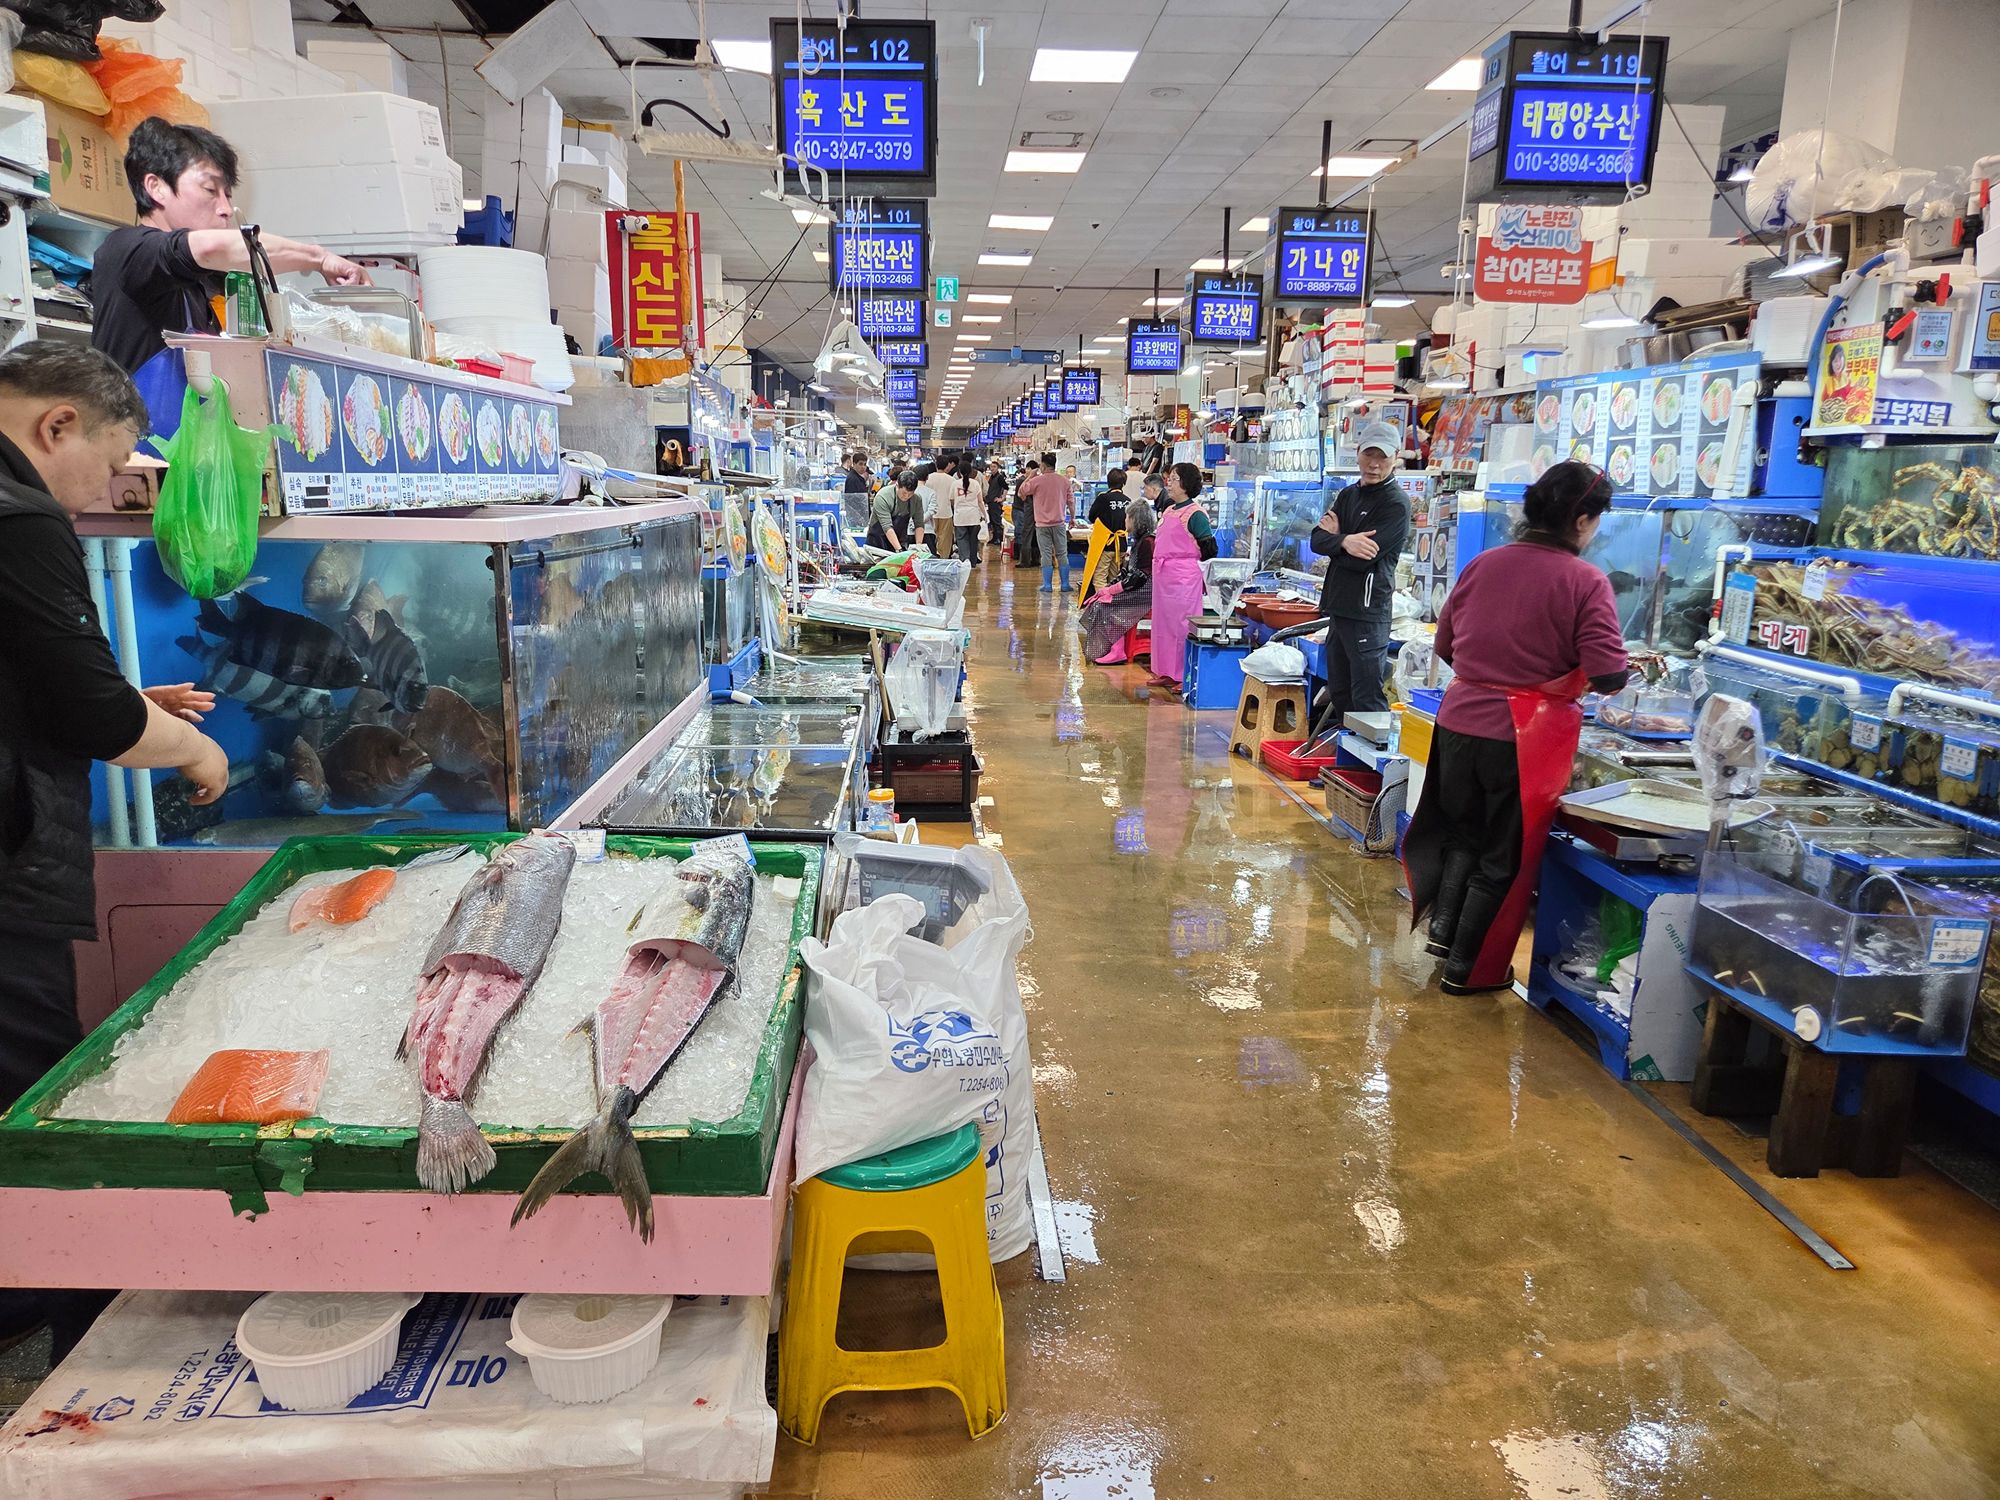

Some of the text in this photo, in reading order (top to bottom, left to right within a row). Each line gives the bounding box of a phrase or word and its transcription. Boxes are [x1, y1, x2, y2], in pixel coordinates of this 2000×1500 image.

[801, 38, 835, 60] 활어
[870, 40, 909, 61] 102
[1532, 51, 1567, 74] 활어
[1600, 54, 1638, 75] 119
[1522, 100, 1640, 141] 태평양수산
[794, 140, 912, 161] 010-3247-3979
[845, 209, 867, 223] 활어
[888, 210, 910, 223] 101
[1293, 217, 1315, 231] 활어
[1335, 219, 1359, 232] 118
[1525, 210, 1574, 228] 노량진
[1501, 228, 1573, 246] 수산데이
[859, 239, 914, 270] 진진수산
[630, 214, 680, 345] 흑산도
[845, 274, 912, 284] 010-7103-2496
[1483, 255, 1583, 285] 참여점포
[1204, 279, 1221, 291] 활어
[1236, 281, 1253, 292] 117
[1287, 281, 1356, 292] 010-8889-7549
[873, 300, 915, 322] 진진수산
[1201, 303, 1254, 326] 공주상회
[1162, 324, 1177, 333] 116
[1134, 340, 1177, 355] 고흥앞바다
[1846, 356, 1878, 377] 부부전복
[1873, 400, 1947, 426] 부부전복
[1759, 621, 1809, 655] 대게
[1665, 923, 1687, 955] HEUNG
[380, 1351, 414, 1392] MARKET
[396, 1350, 432, 1399] FISHERIES
